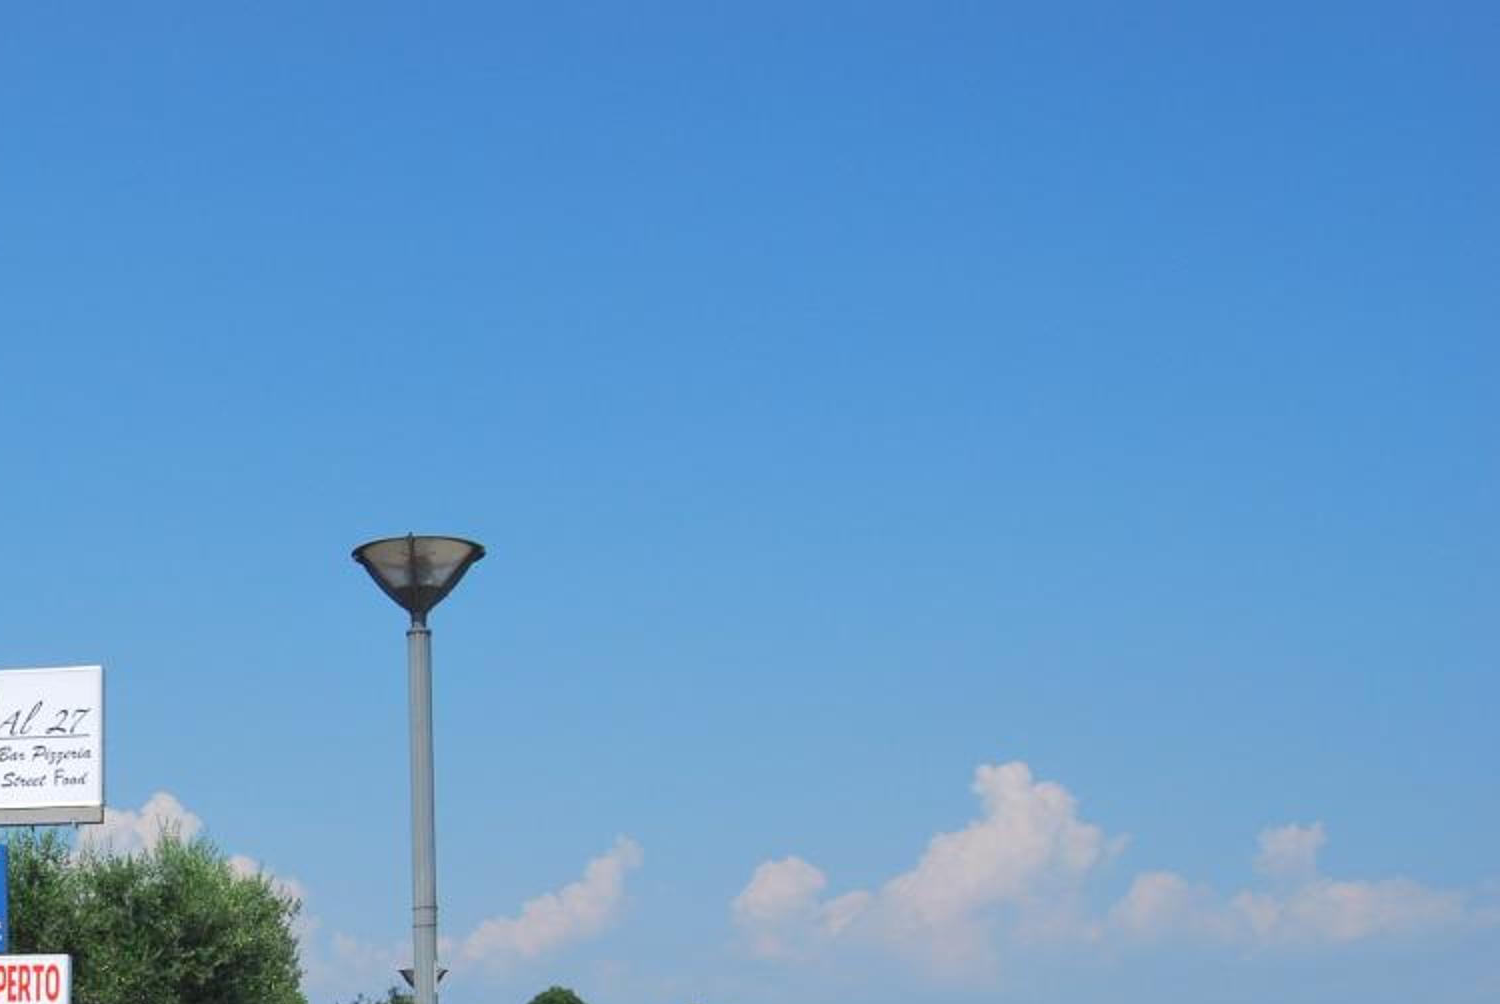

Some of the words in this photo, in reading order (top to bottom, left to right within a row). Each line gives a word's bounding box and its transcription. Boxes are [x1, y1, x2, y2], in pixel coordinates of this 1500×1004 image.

[46, 707, 92, 736] 27
[32, 744, 92, 766] Pizzeria
[1, 771, 47, 788] Street
[53, 768, 88, 786] Food
